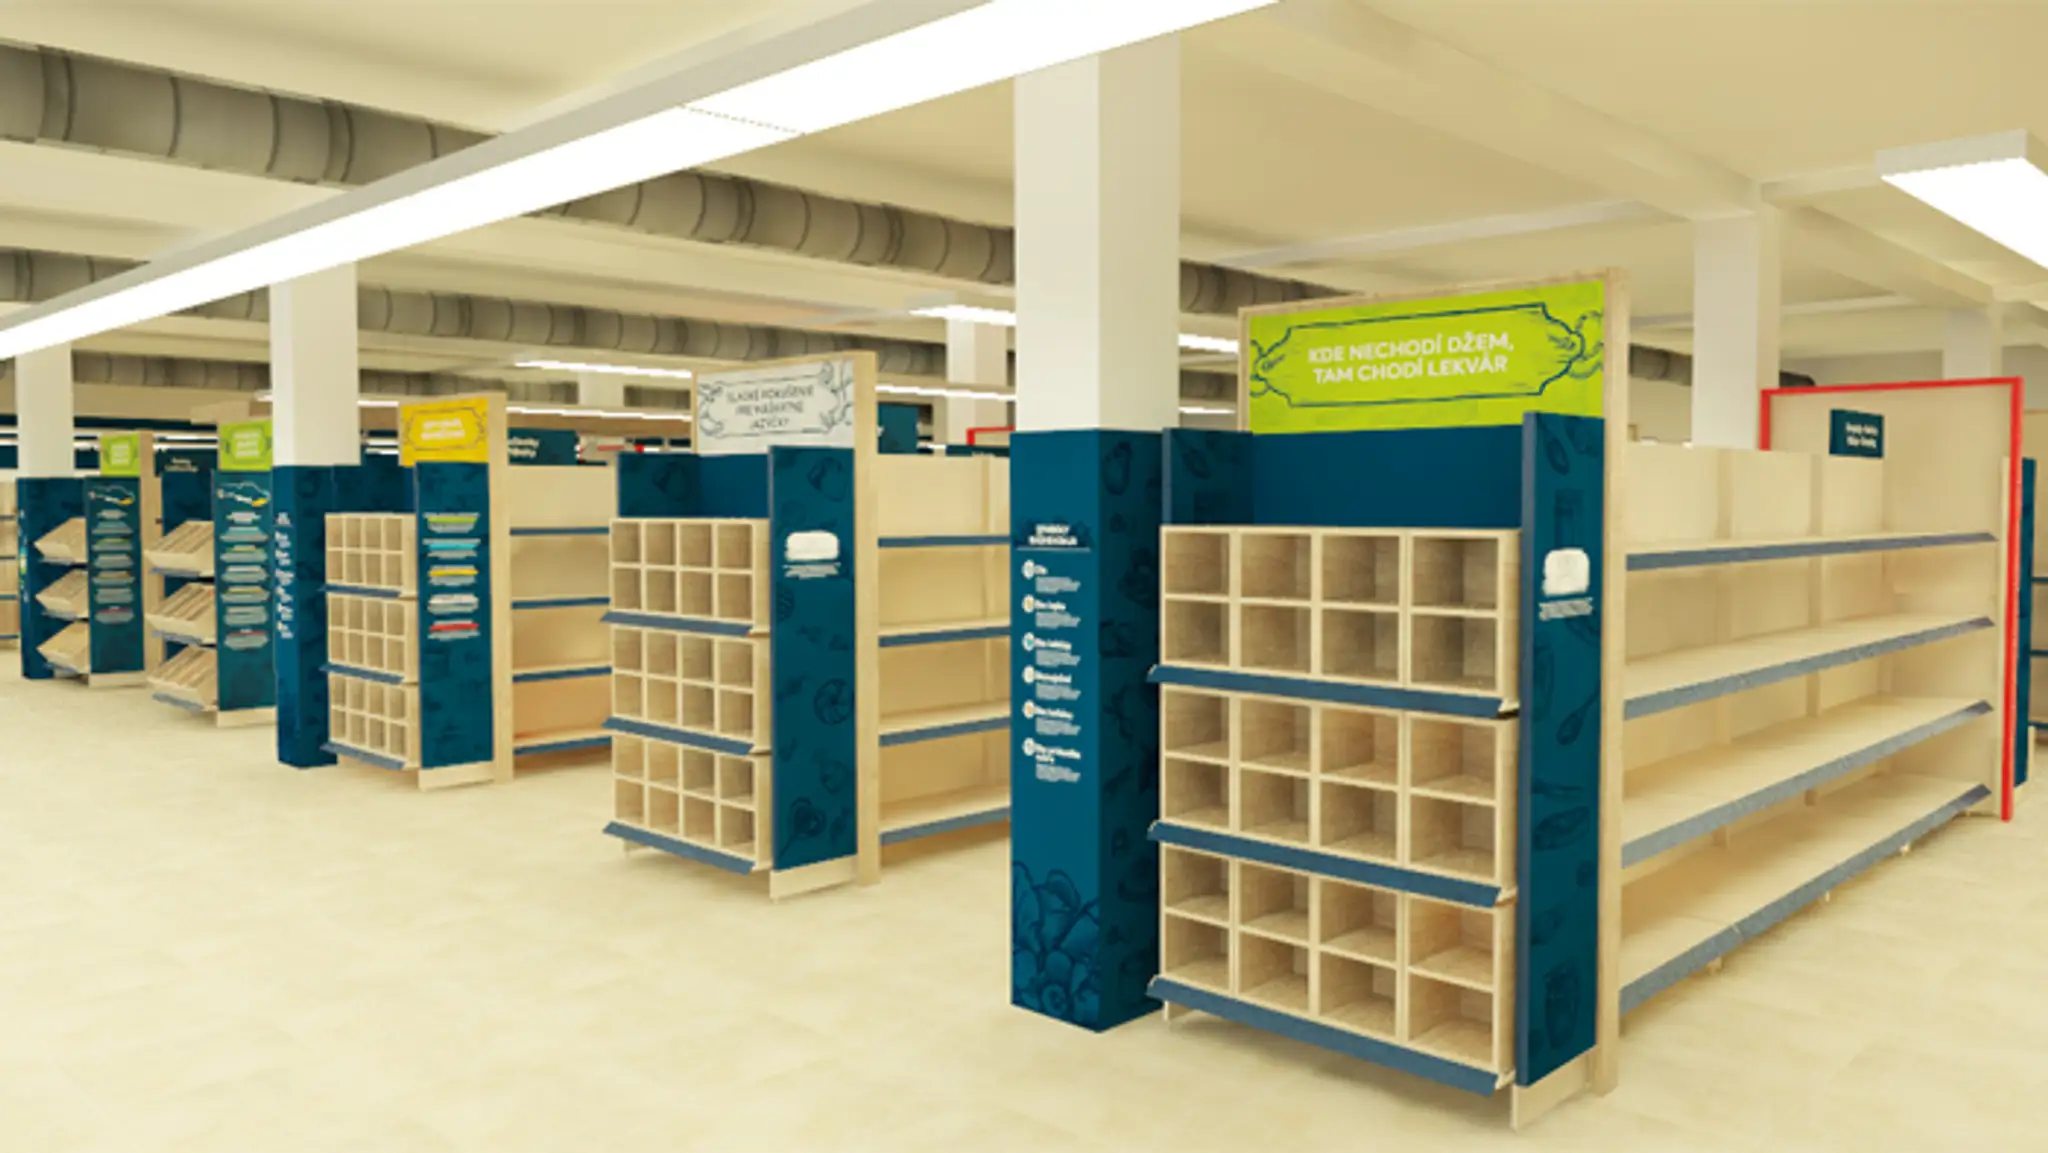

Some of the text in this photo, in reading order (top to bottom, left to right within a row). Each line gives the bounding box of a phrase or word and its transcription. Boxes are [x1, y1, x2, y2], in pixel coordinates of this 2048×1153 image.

[1308, 331, 1514, 364] KDE NECHODÍ DŽEM,
[1312, 353, 1508, 384] TAM CHODÍ LEKVÁR
